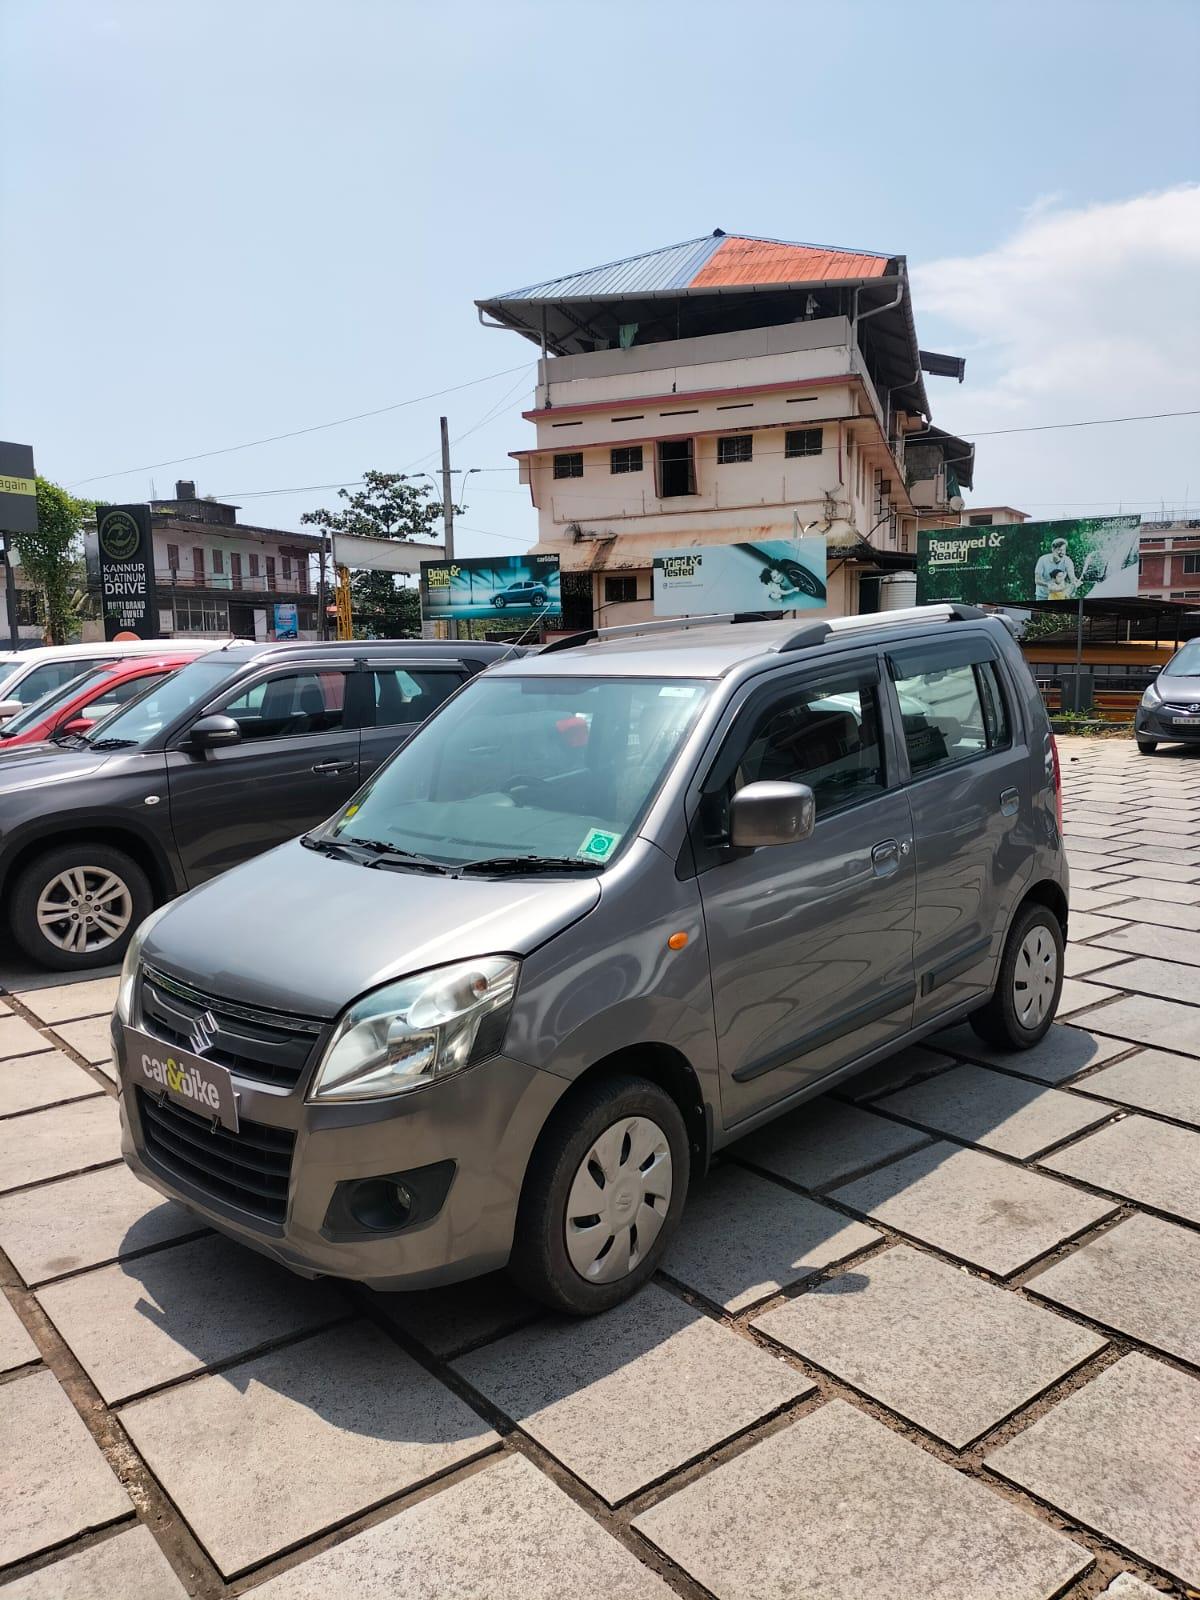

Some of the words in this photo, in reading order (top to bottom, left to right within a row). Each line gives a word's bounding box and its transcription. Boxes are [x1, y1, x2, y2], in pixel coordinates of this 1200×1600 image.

[0, 479, 27, 491] again
[929, 536, 986, 551] Renewed
[989, 533, 1005, 547] &
[929, 547, 966, 563] Ready
[103, 563, 145, 573] KANNUR
[662, 556, 688, 569] Tried
[428, 567, 449, 578] Drive
[450, 565, 461, 577] &
[663, 566, 694, 578] Tested
[103, 573, 146, 583] PLATINUM
[428, 576, 450, 586] Smile
[104, 582, 147, 595] DRIVE
[125, 600, 146, 610] BRAND
[122, 609, 144, 618] OWNED
[119, 618, 136, 627] CARS
[141, 1054, 220, 1110] car&bike
